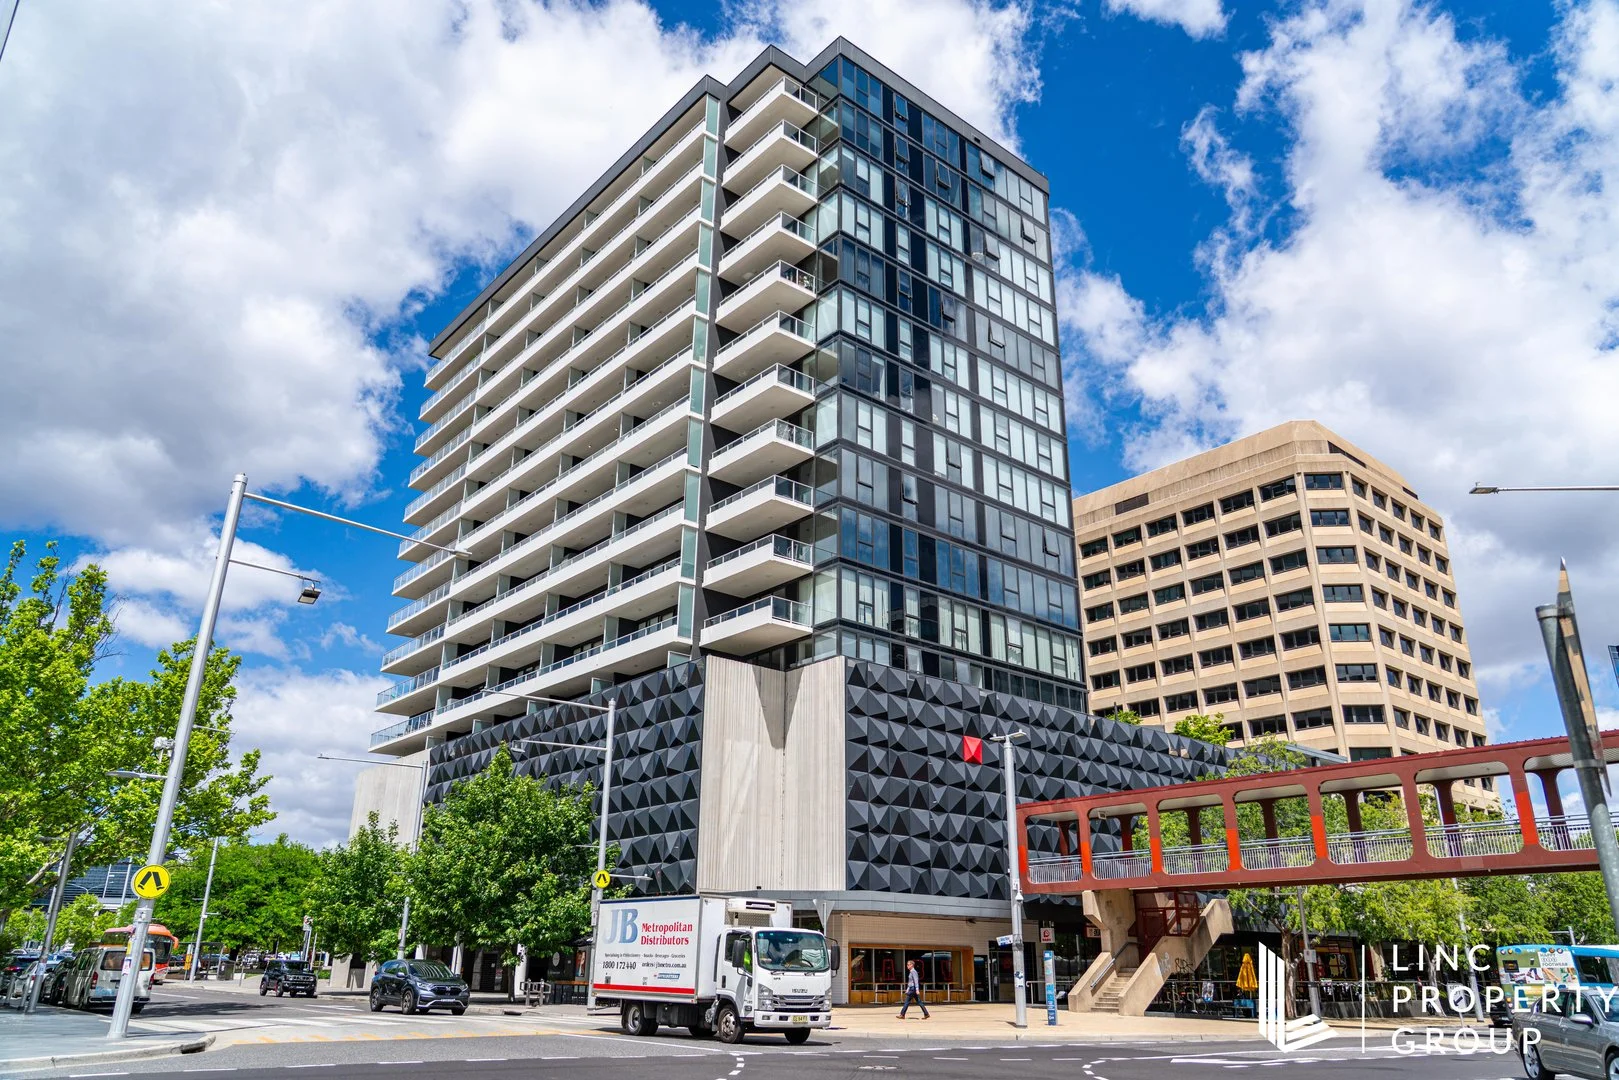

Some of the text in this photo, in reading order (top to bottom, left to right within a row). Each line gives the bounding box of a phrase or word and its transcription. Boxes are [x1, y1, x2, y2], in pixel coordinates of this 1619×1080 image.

[602, 908, 639, 944] JB
[641, 921, 693, 935] Metropolitan
[640, 935, 690, 945] Distributors
[602, 960, 616, 969] 1800
